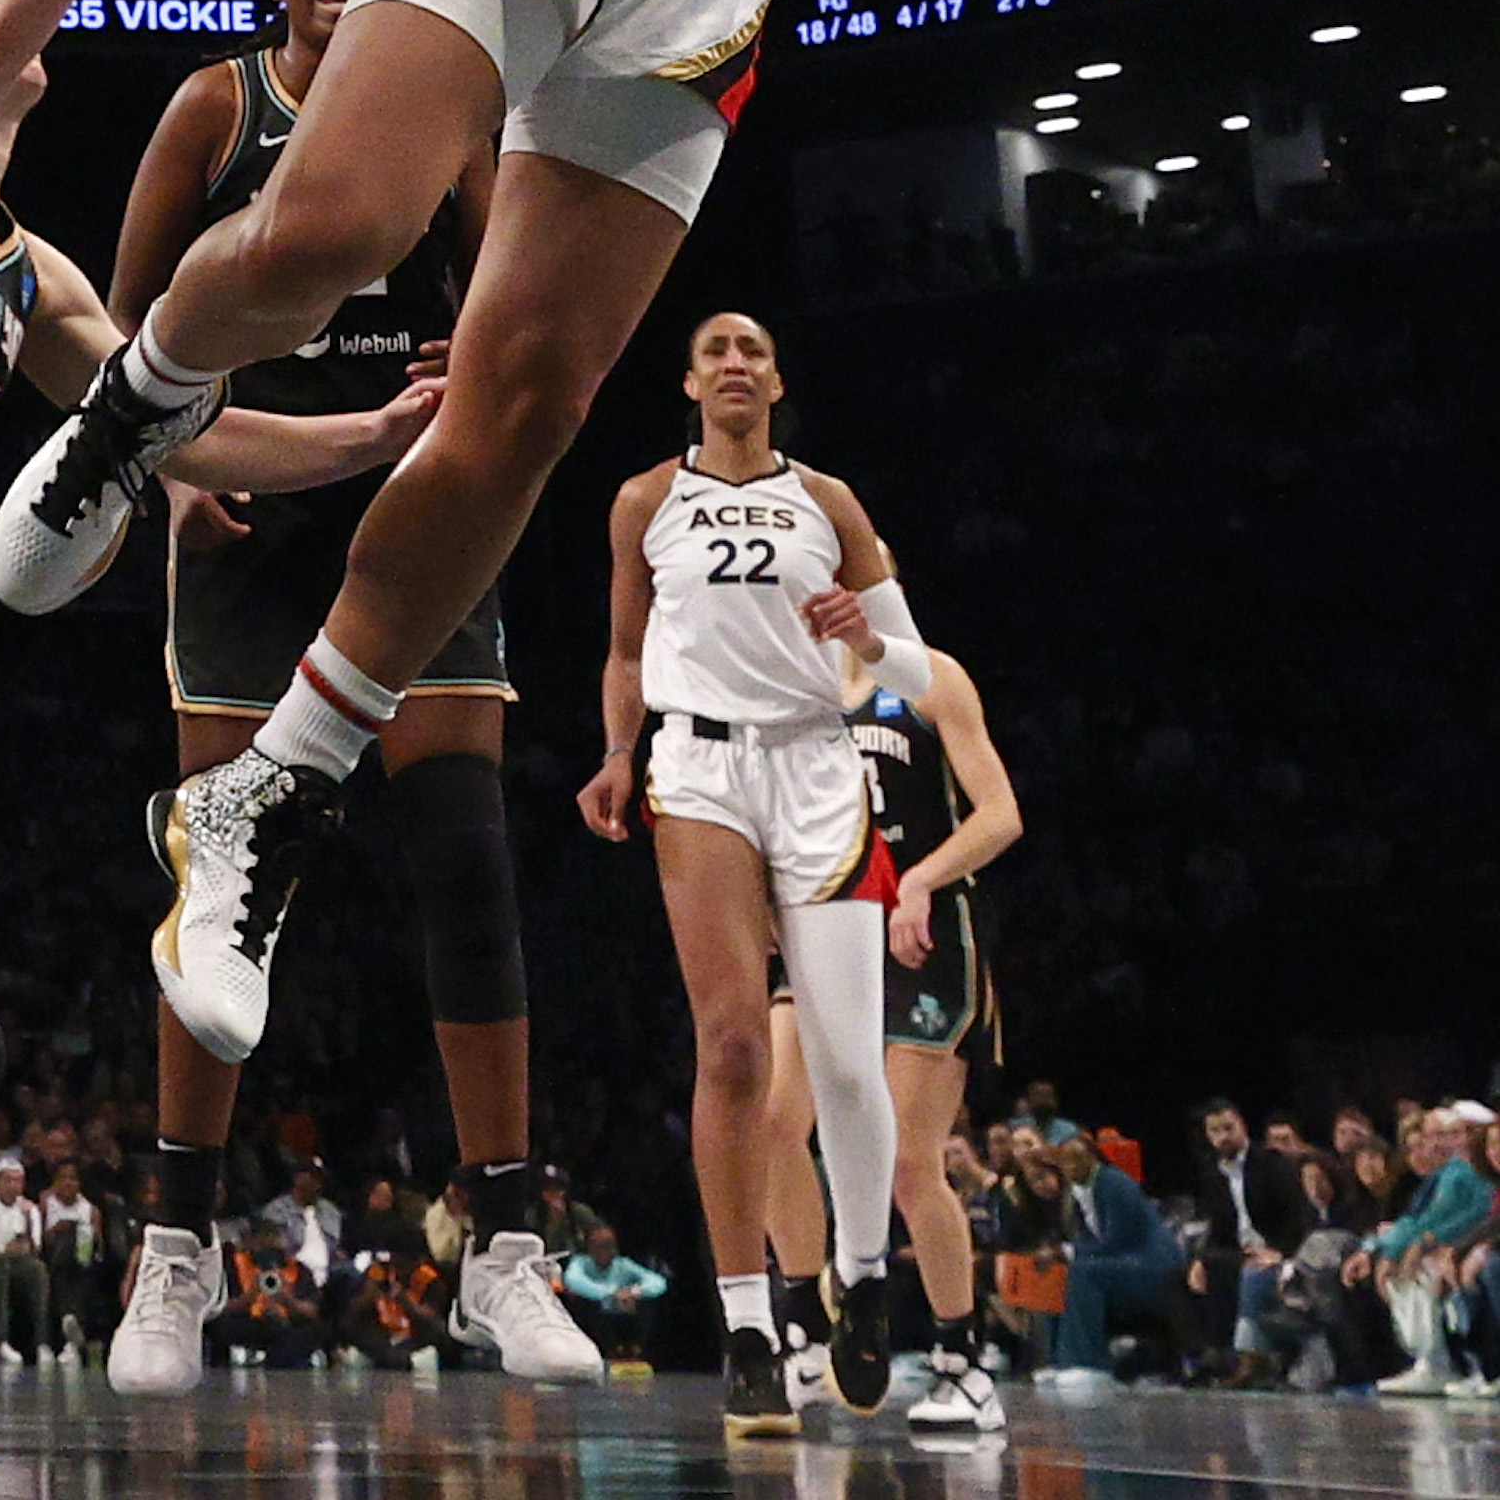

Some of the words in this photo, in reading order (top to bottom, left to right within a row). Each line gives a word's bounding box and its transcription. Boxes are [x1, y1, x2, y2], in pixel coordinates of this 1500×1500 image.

[115, 0, 256, 32] VICKIE
[340, 331, 411, 355] Webull
[688, 506, 797, 531] ACES
[706, 538, 780, 586] 22
